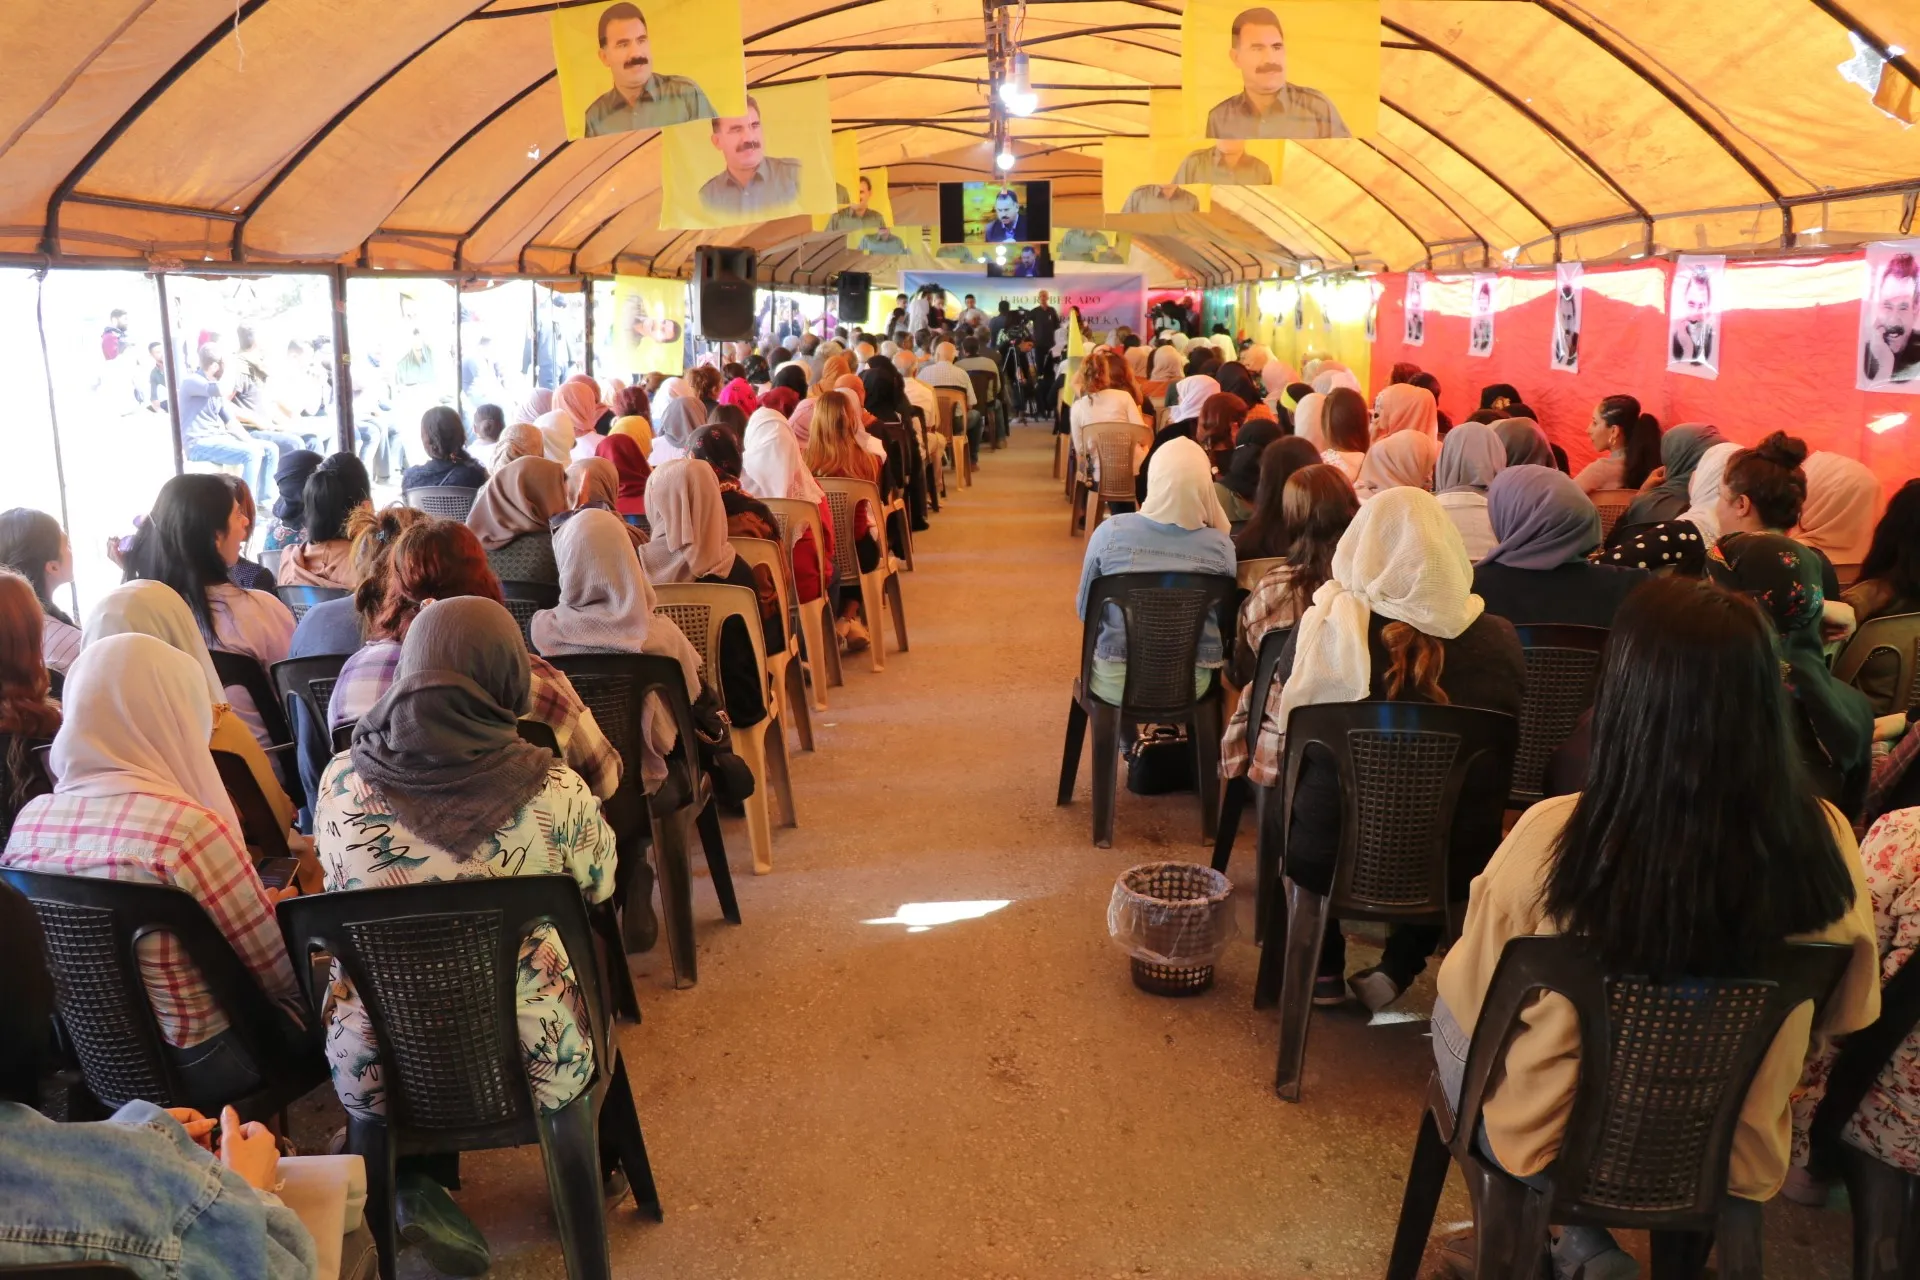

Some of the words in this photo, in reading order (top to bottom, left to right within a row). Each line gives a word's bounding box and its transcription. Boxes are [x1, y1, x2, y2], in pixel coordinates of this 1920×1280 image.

[1012, 295, 1029, 304] BO
[1033, 295, 1073, 304] RBER
[1078, 295, 1101, 304] APO
